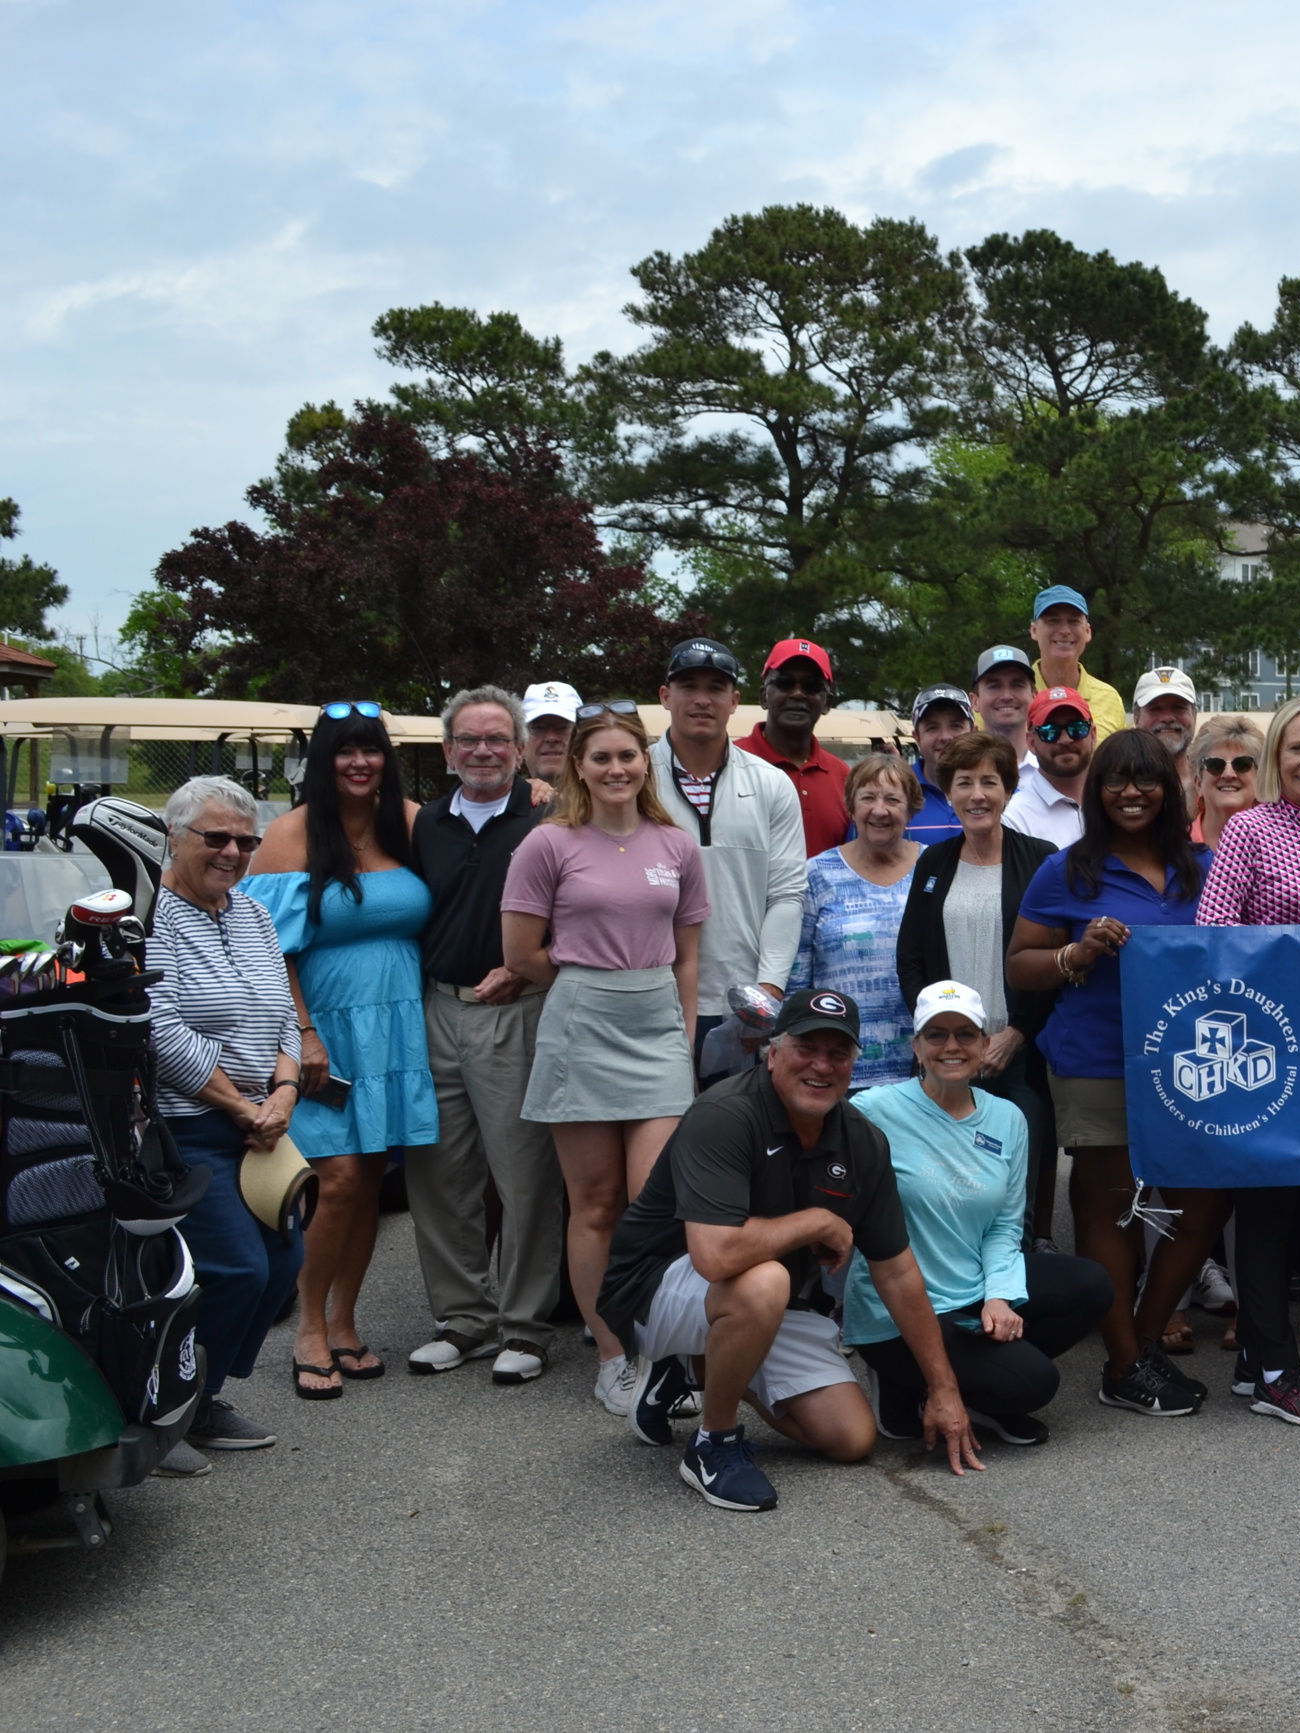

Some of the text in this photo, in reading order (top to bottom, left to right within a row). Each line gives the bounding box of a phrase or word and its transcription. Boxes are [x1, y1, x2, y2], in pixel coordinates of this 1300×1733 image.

[108, 814, 158, 847] TaylorMade
[1144, 978, 1299, 1056] The King's Daughters
[1150, 1065, 1298, 1137] Founders of Children's Hospital
